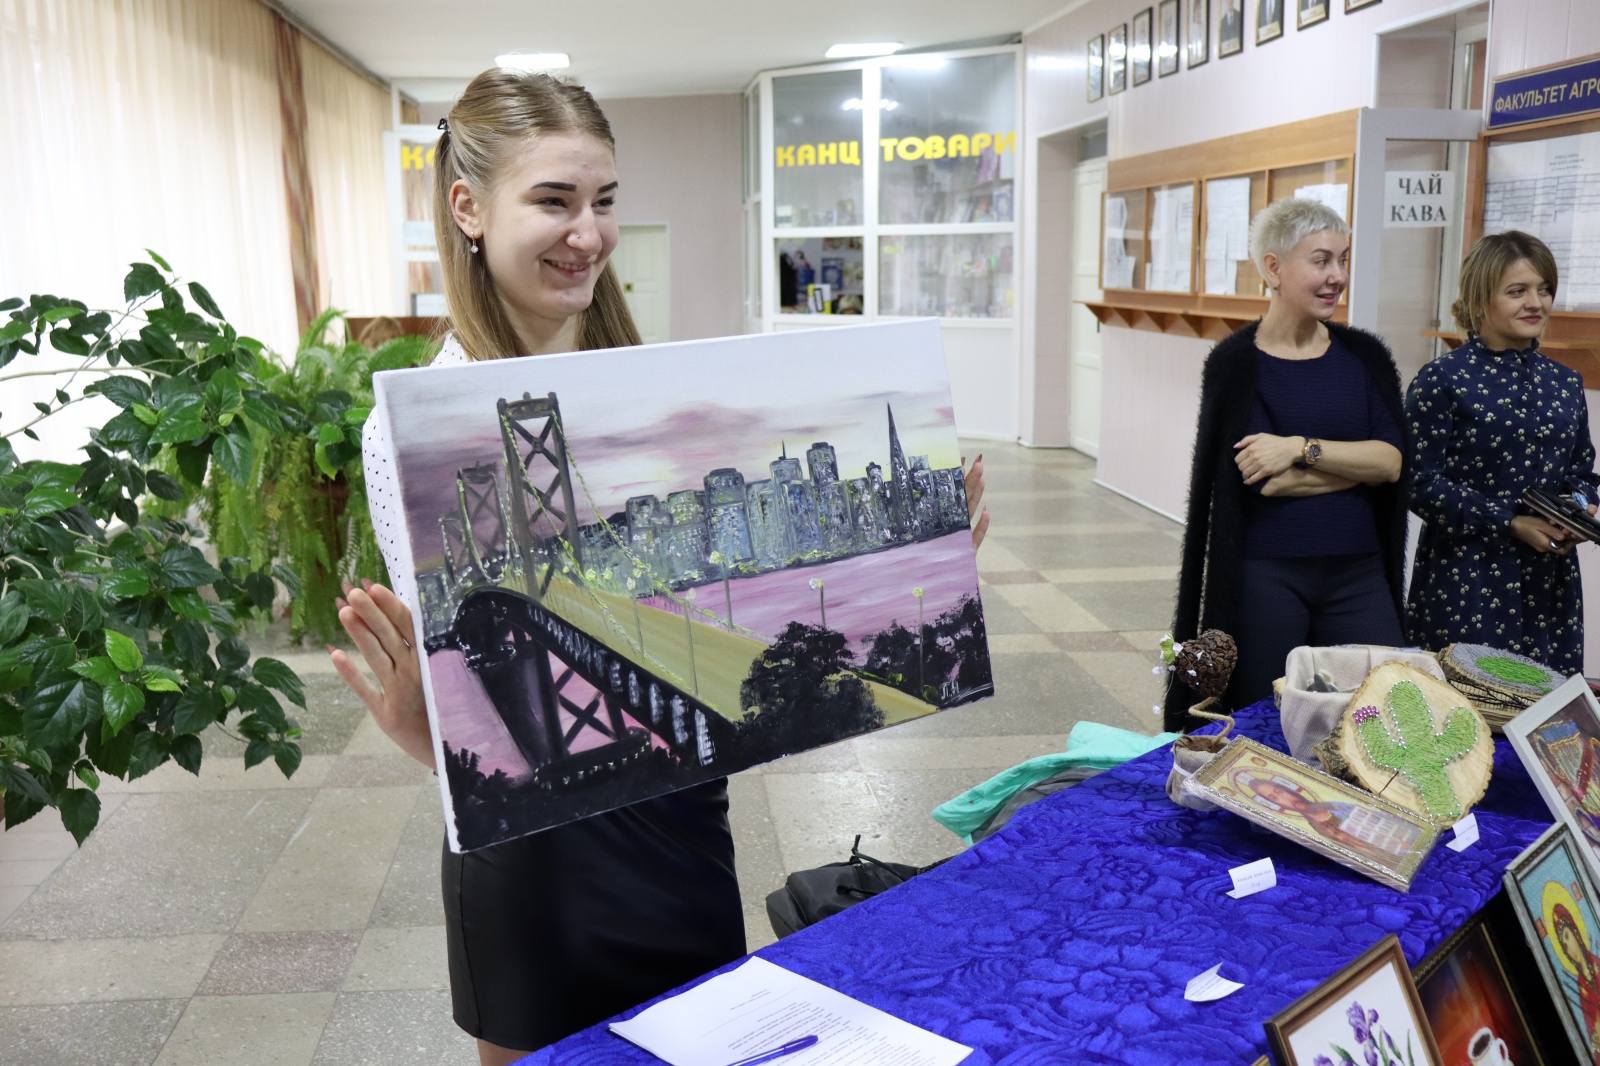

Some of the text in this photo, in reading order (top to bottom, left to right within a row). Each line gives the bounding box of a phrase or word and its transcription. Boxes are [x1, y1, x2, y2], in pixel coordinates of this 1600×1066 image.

[1495, 84, 1567, 112] ФАКУЛЬТЕТ
[776, 131, 1016, 167] КАНЦ ТОВАРИ
[1398, 173, 1442, 195] ЧАЙ
[1391, 204, 1447, 222] КАВА
